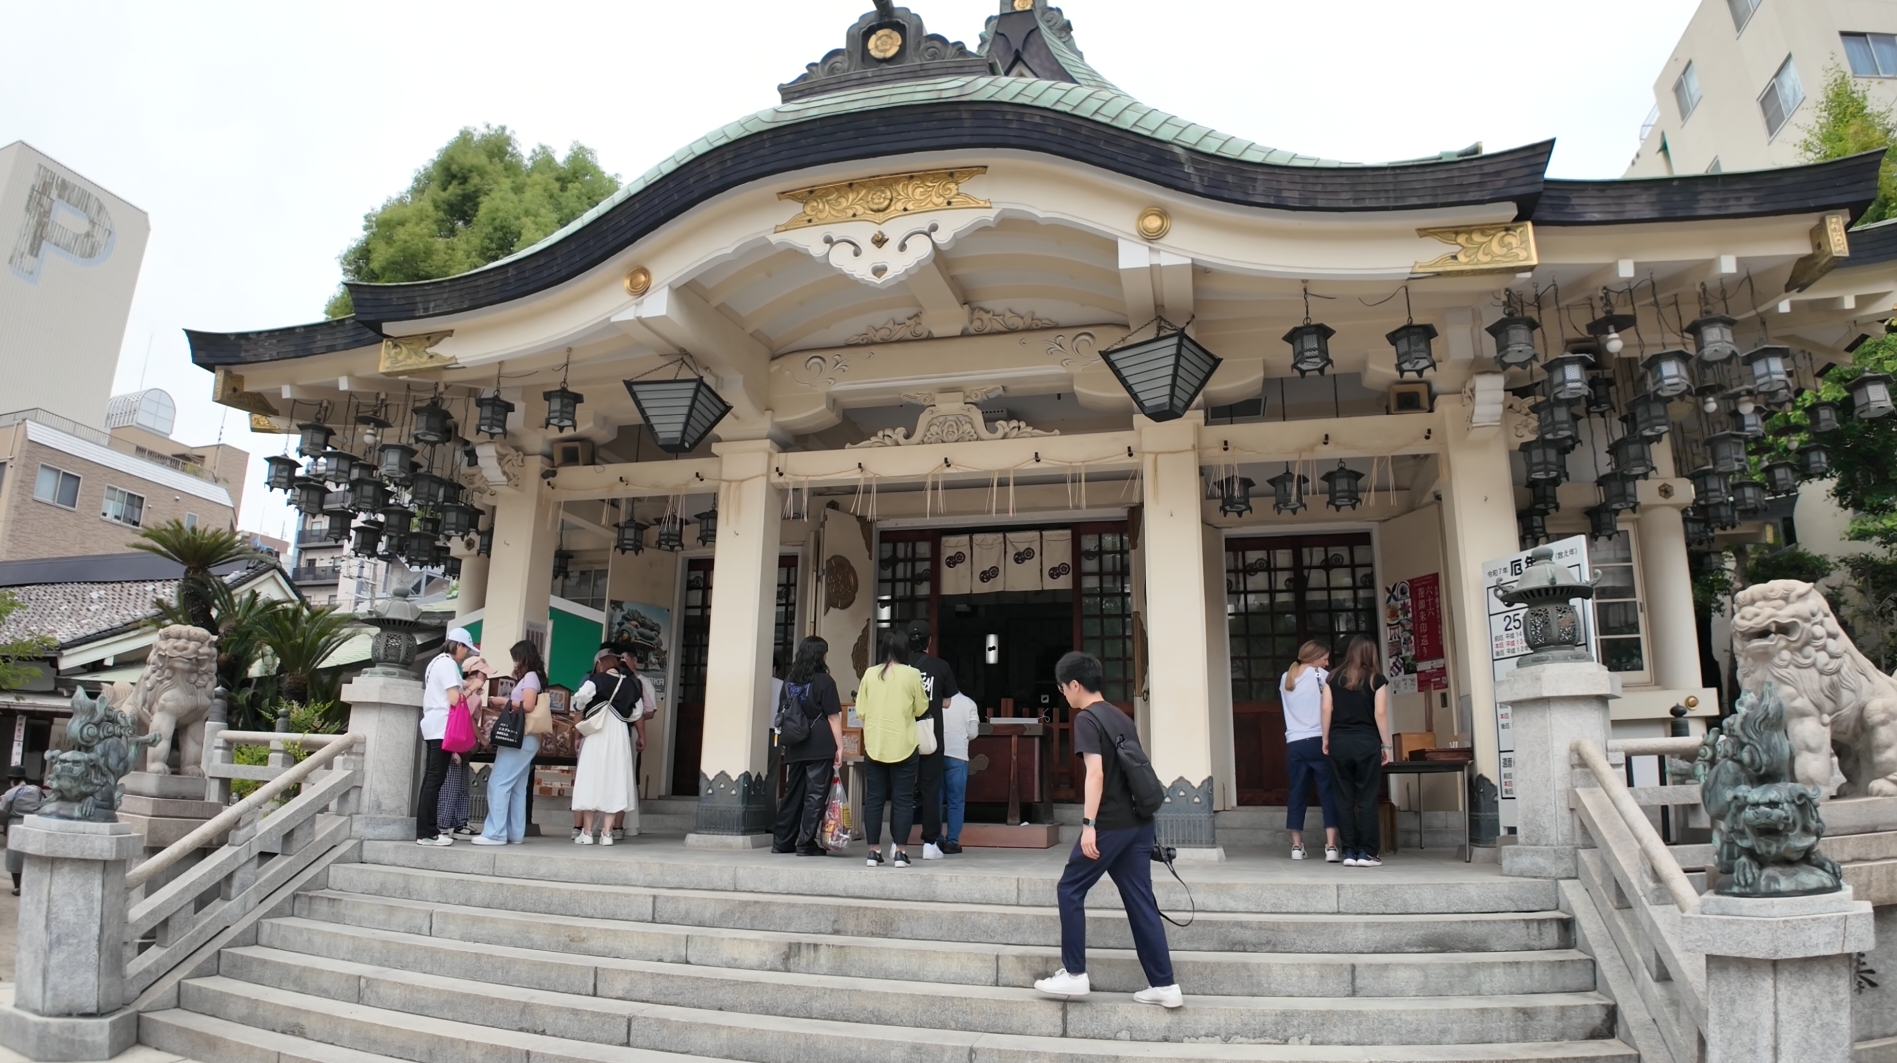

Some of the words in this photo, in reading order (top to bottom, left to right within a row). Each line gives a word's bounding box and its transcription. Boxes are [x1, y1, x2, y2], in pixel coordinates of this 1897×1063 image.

[8, 163, 116, 285] P
[1418, 587, 1429, 657] 花御朱印巡り
[1426, 585, 1435, 617] 六十六
[1503, 613, 1521, 631] 25
